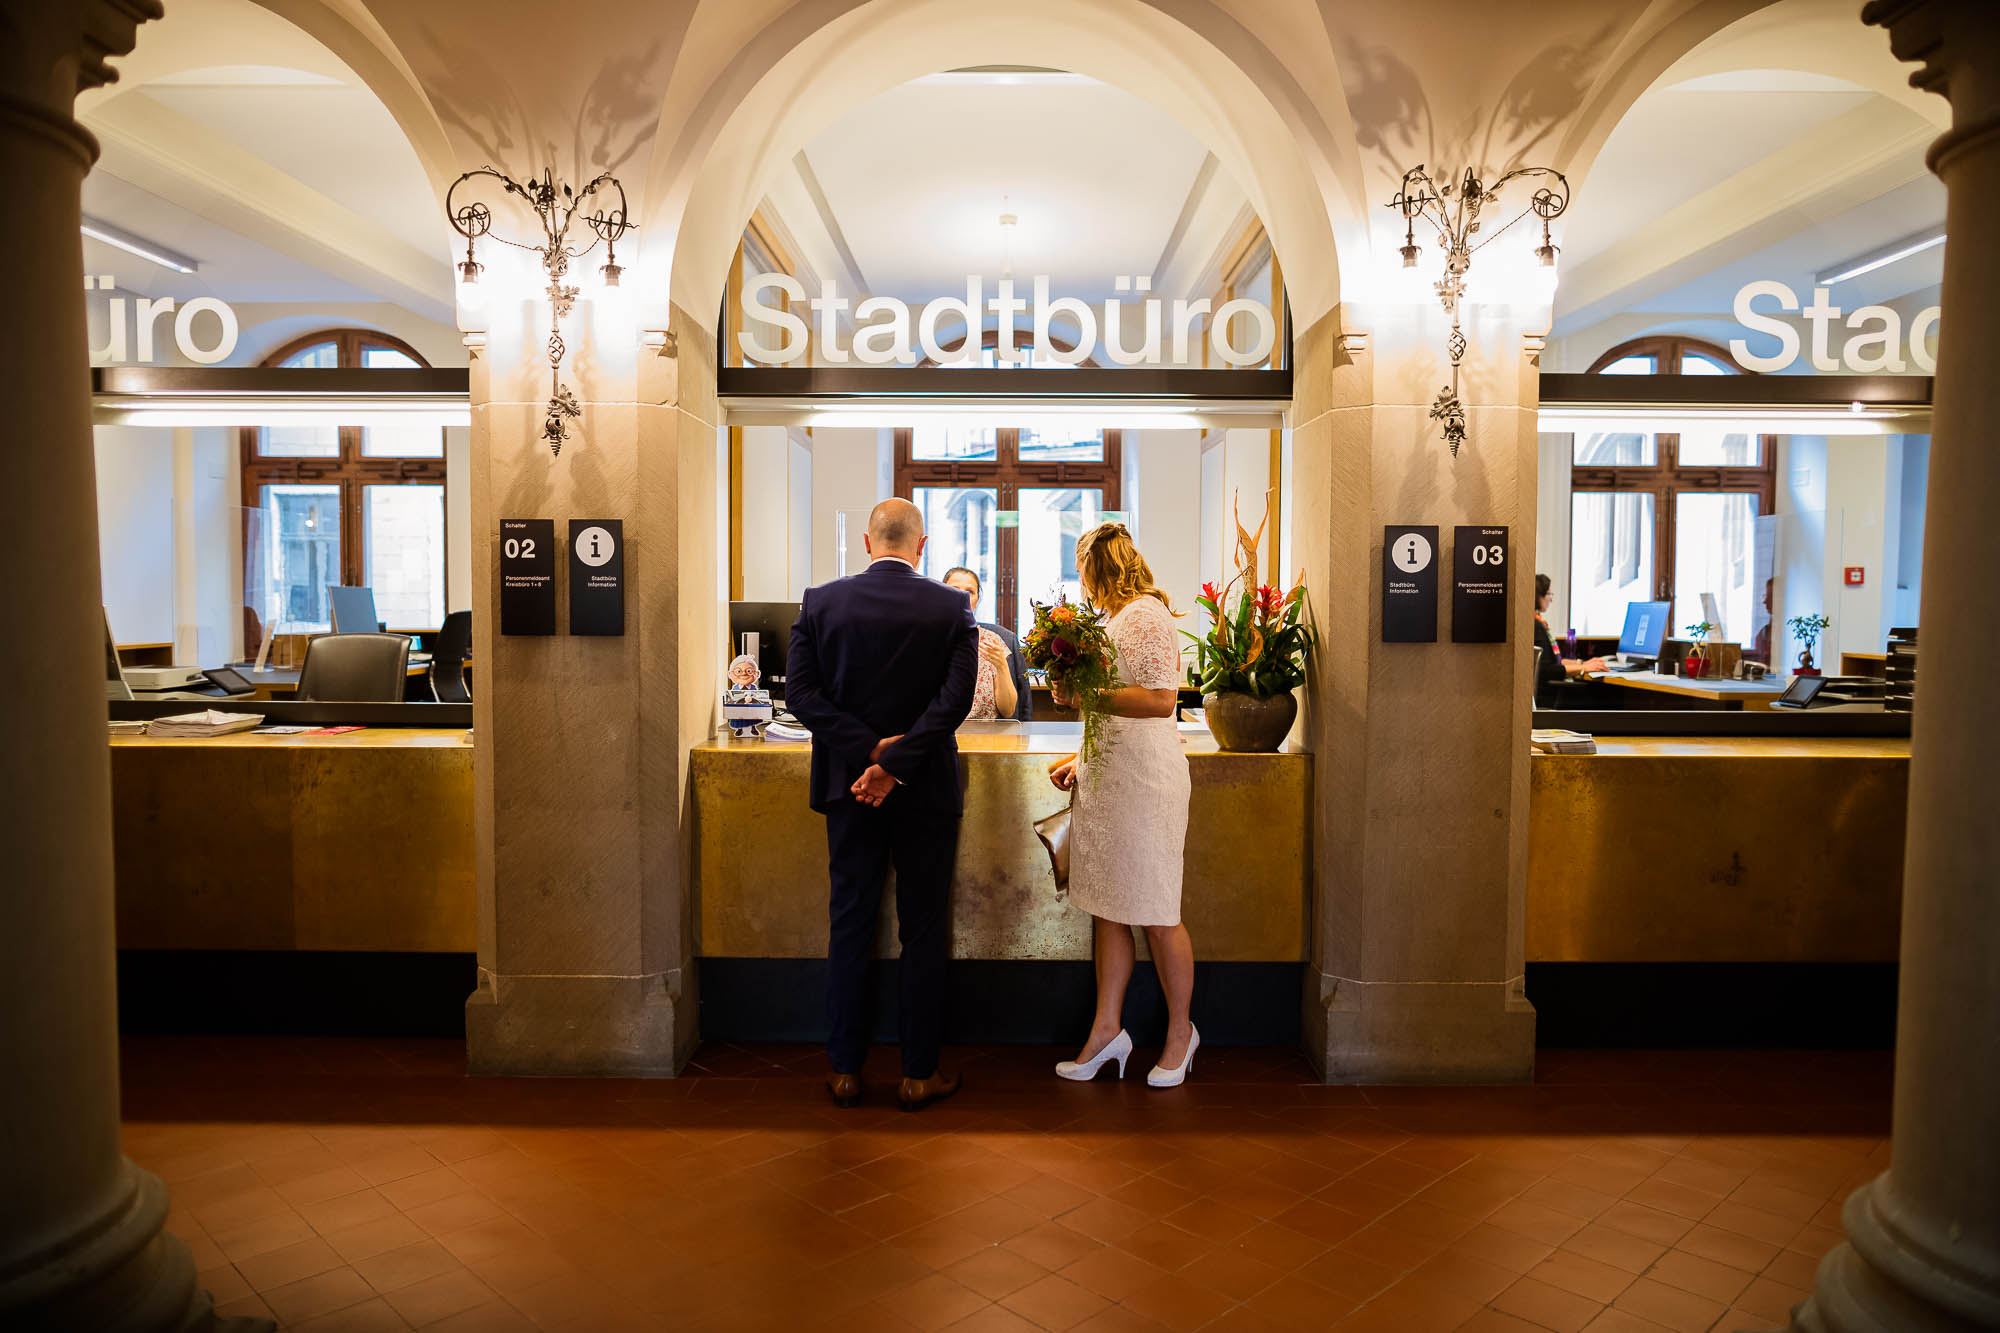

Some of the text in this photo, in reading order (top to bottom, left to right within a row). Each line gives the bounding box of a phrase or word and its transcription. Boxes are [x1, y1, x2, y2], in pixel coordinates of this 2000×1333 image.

[737, 272, 1277, 365] Stadtbüro
[504, 538, 536, 559] 02
[1472, 545, 1504, 565] 03
